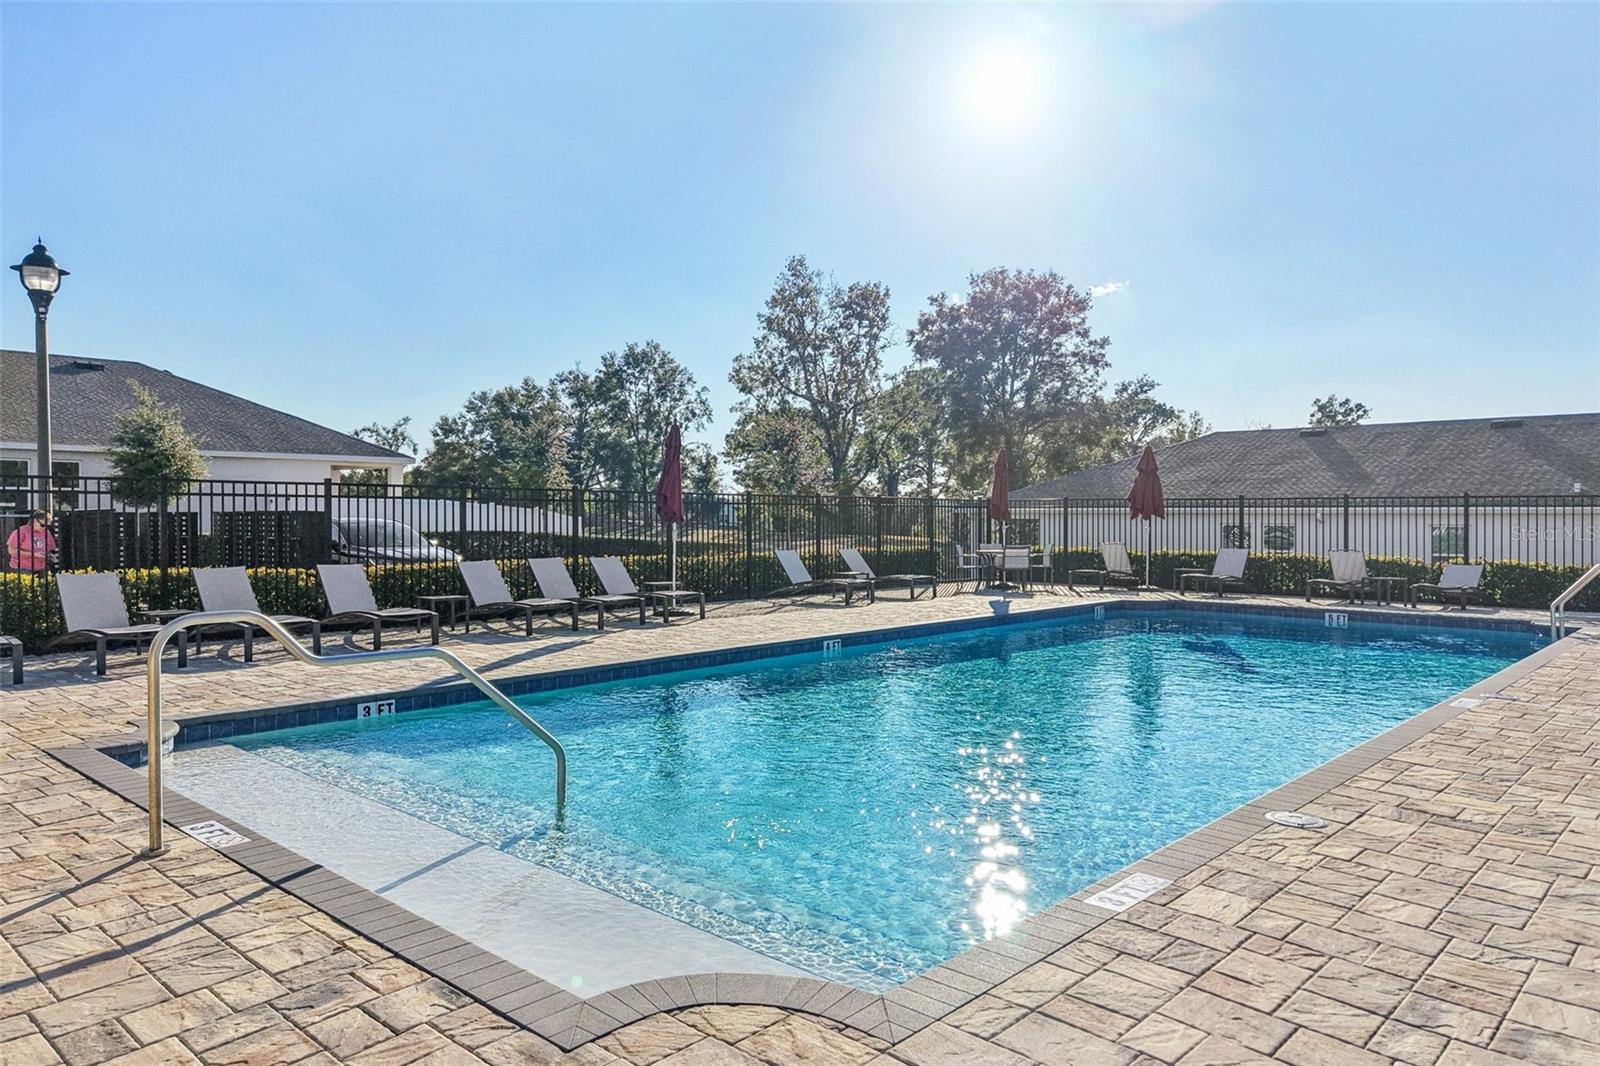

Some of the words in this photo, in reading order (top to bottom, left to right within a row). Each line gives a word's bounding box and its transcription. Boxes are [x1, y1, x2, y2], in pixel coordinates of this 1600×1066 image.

[1337, 615, 1347, 627] FT
[832, 641, 841, 650] FT
[362, 705, 372, 718] 3
[377, 702, 394, 716] FT
[196, 828, 232, 840] FT
[1106, 884, 1151, 900] FT
[1097, 896, 1127, 907] 3
